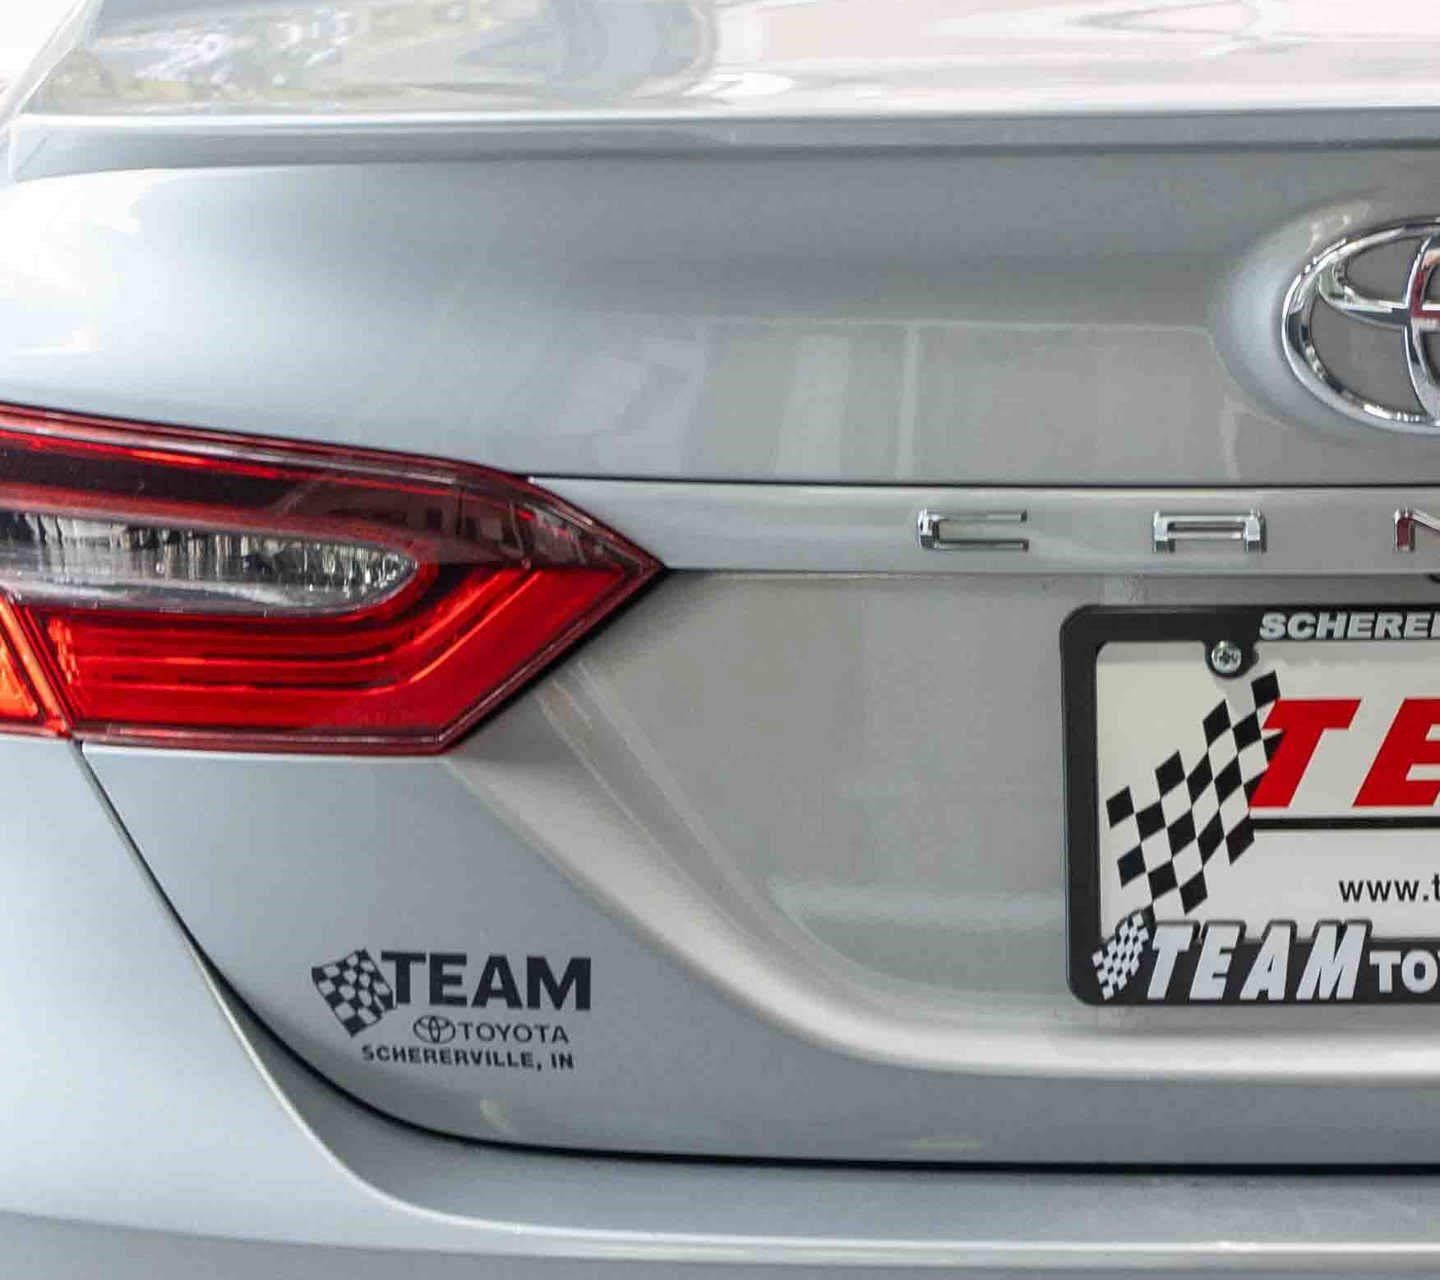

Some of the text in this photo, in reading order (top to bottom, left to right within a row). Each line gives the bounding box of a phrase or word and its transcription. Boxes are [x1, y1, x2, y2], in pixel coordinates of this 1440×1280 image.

[381, 950, 591, 1011] TEAM
[1146, 922, 1370, 1000] TEAM
[458, 1021, 569, 1045] TOYOTA
[362, 1044, 574, 1071] SCHERERVILLE, IN
